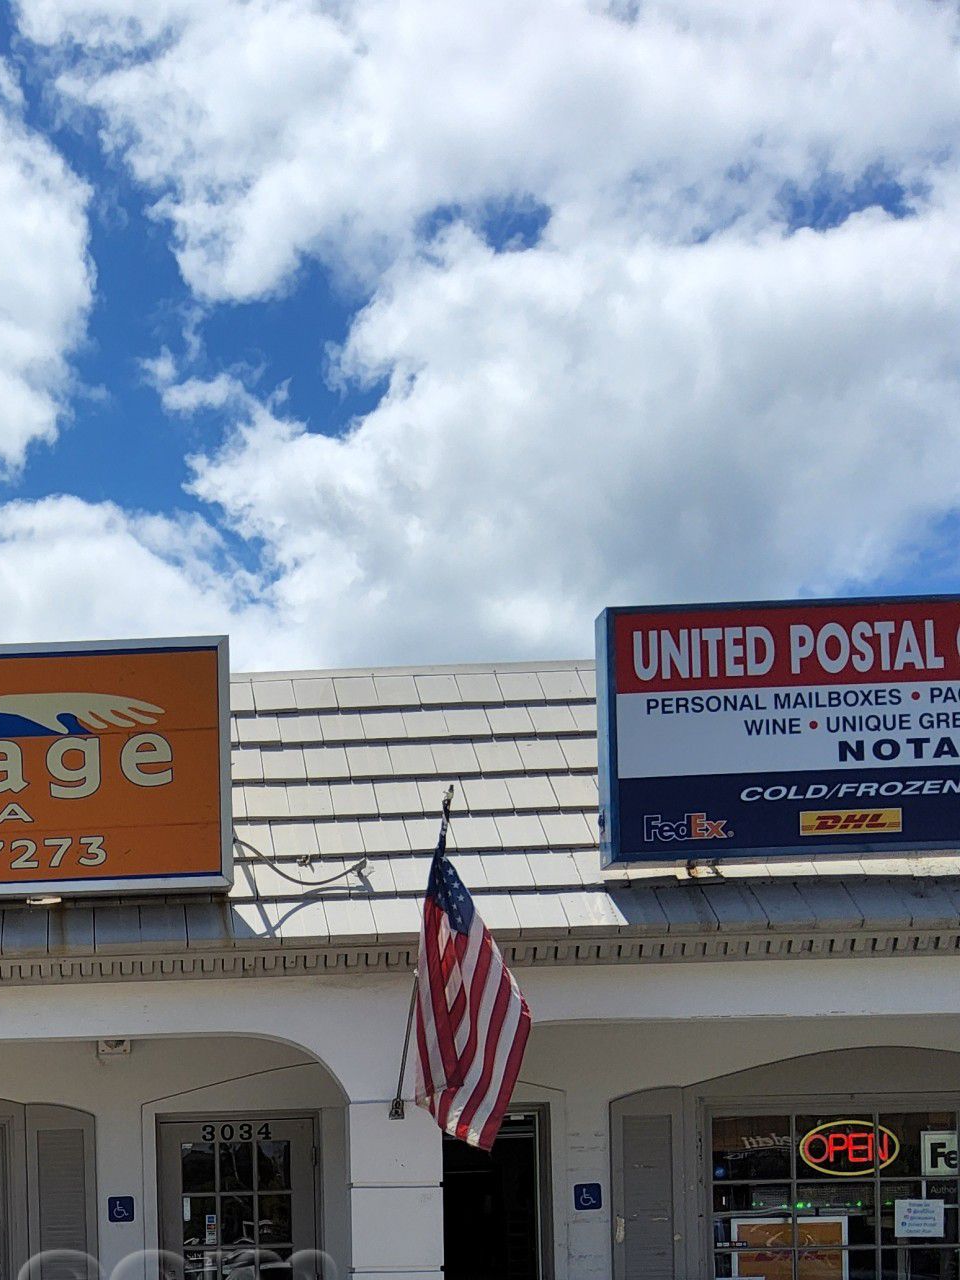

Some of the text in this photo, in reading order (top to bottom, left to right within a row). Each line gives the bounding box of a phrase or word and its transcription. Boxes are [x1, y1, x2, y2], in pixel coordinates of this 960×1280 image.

[633, 625, 775, 681] UNITED
[789, 619, 945, 675] POSTAL
[646, 694, 767, 715] PERSONAL
[774, 689, 902, 711] MAILBOXES
[744, 718, 802, 736] WINE
[826, 714, 912, 733] UNIQUE
[838, 736, 960, 762] NOTA
[740, 780, 960, 802] COLD/FROZEN
[813, 813, 889, 831] DHL
[201, 1123, 272, 1142] 3034
[803, 1132, 889, 1163] OPEN
